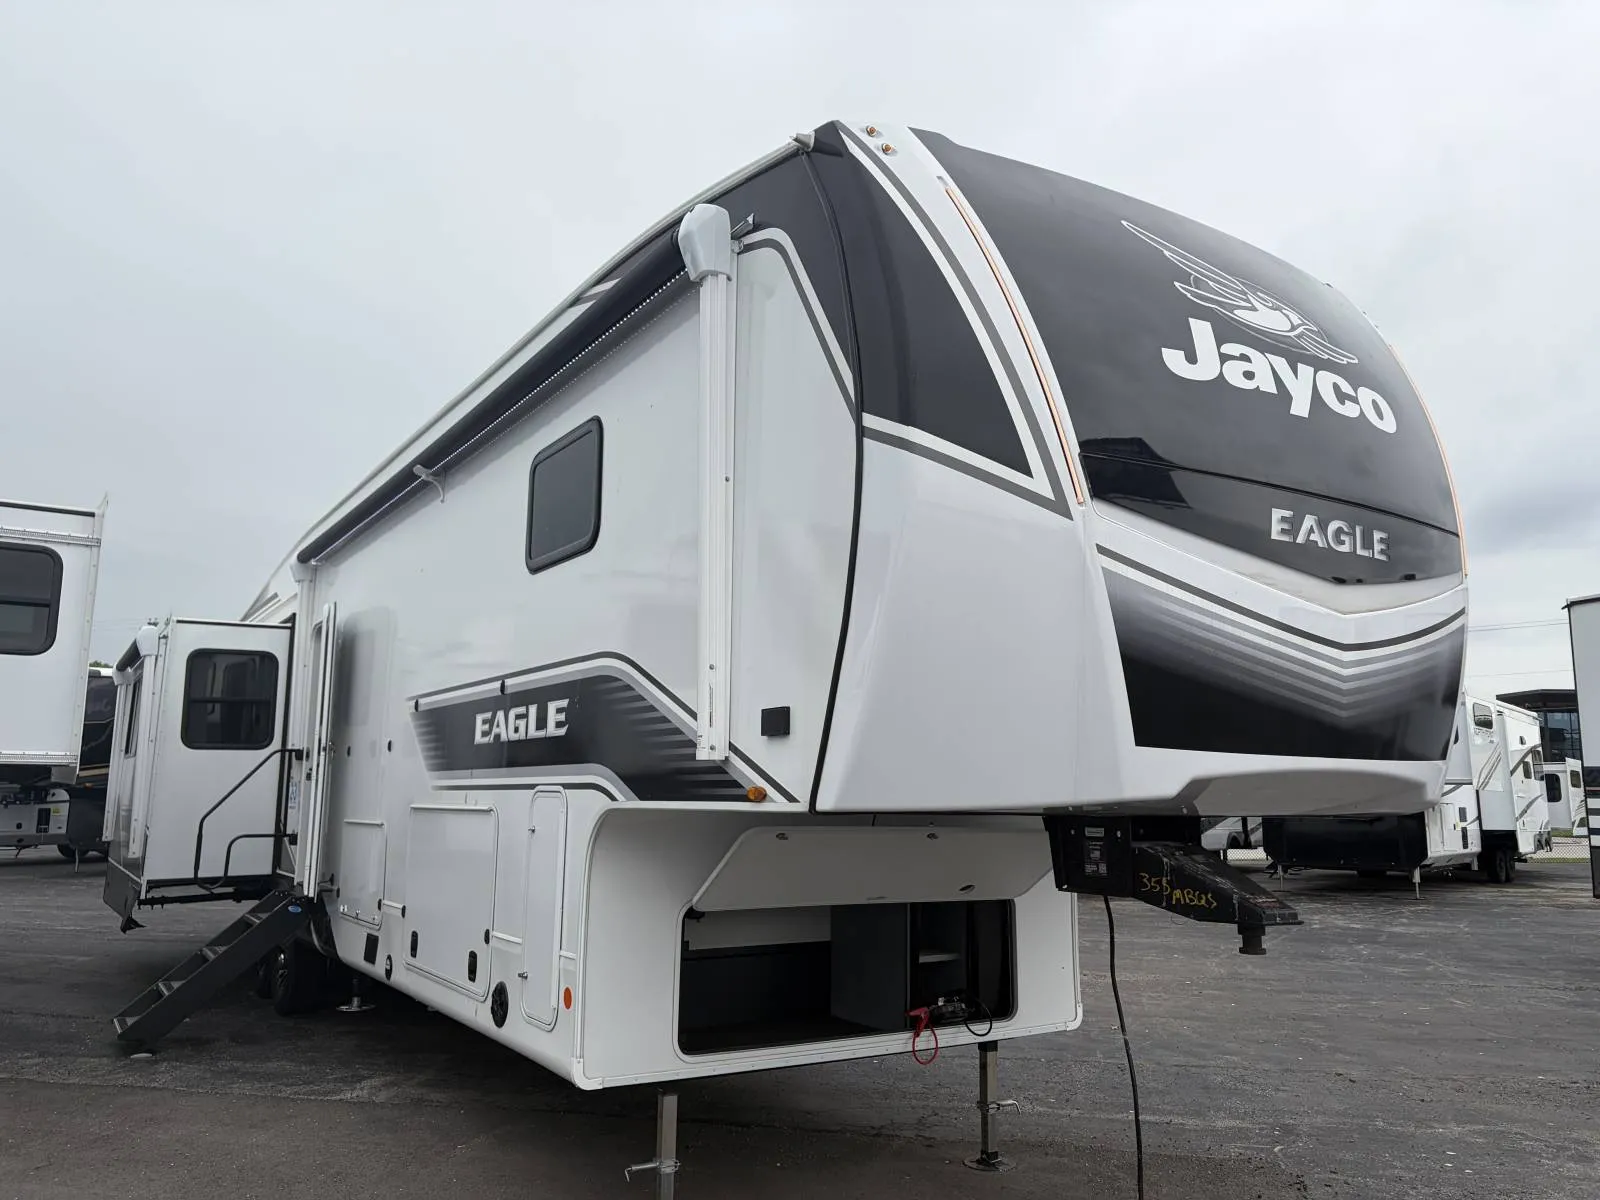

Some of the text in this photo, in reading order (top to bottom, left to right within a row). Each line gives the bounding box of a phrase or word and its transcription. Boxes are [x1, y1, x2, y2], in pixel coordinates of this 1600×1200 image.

[1161, 317, 1397, 433] Jayco
[1271, 507, 1391, 561] EAGLE
[474, 698, 569, 745] EAGLE
